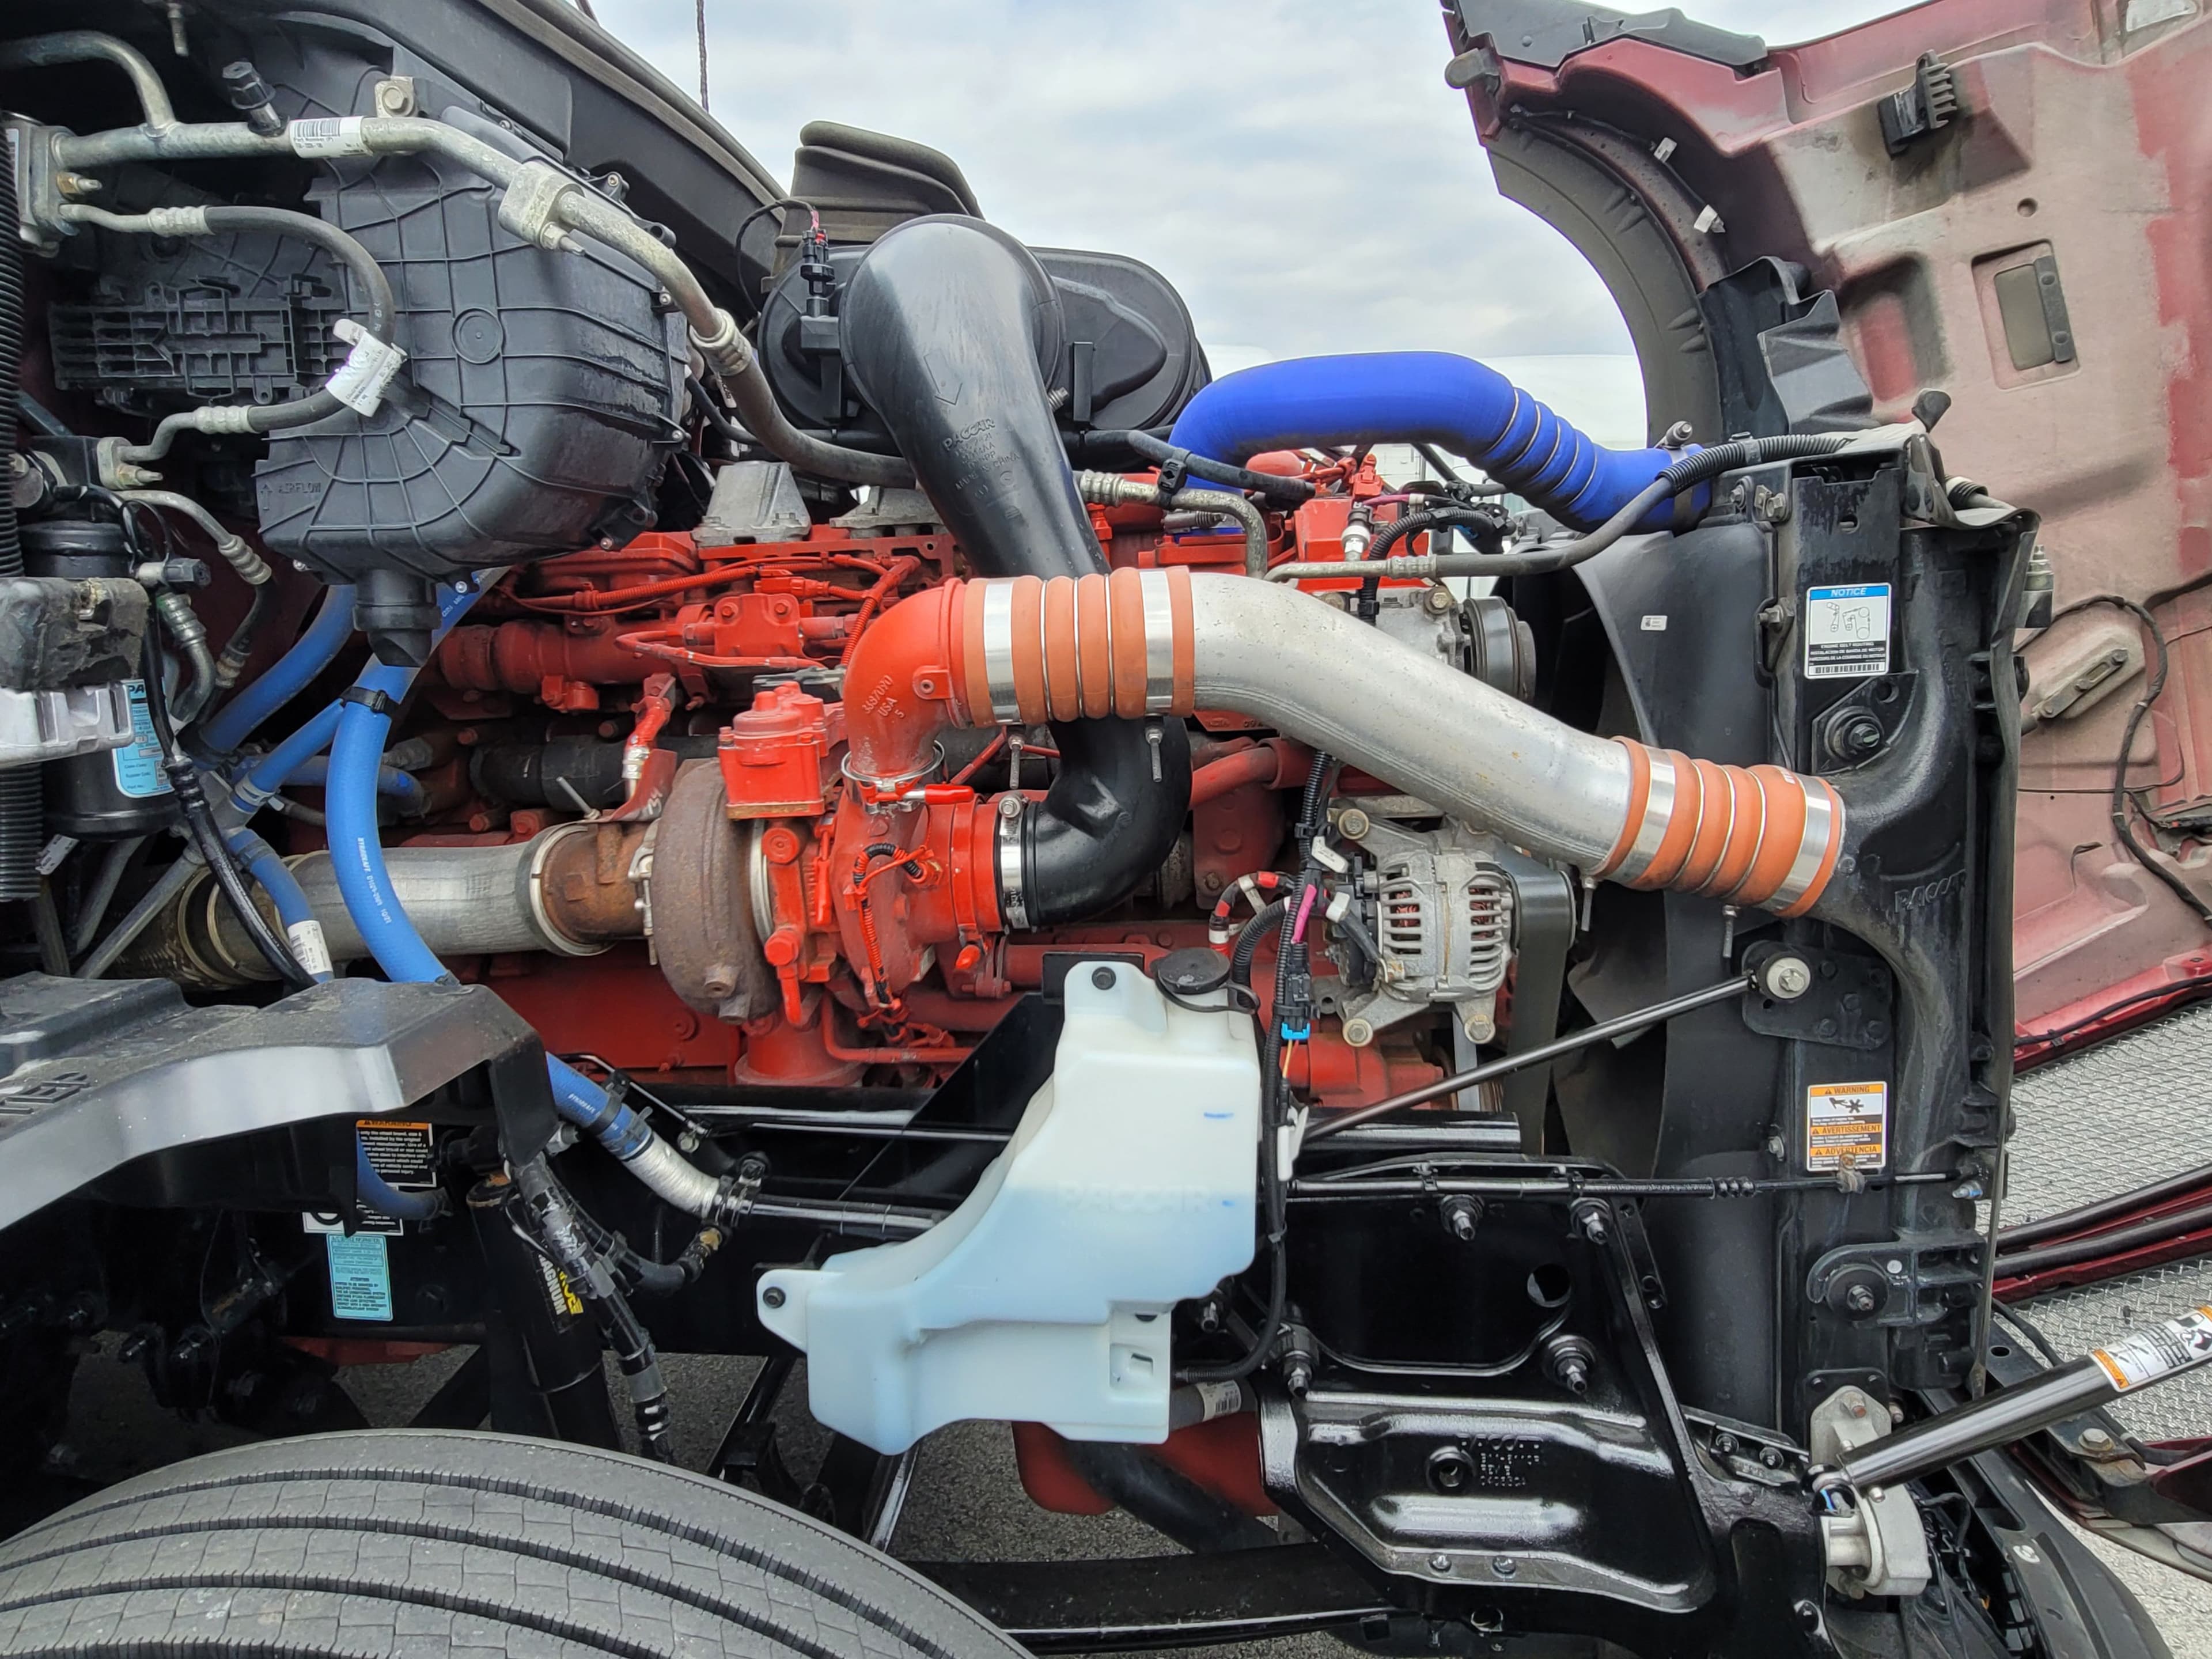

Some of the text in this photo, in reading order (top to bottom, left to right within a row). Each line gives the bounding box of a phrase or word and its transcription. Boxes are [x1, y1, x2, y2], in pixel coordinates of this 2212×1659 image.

[942, 418, 996, 452] PACCAR
[1831, 588, 1867, 597] NOTICE
[877, 698, 897, 716] USA
[1834, 1086, 1870, 1094] WARNING
[1822, 1124, 1880, 1134] AVERTISSEMENT
[1825, 1146, 1877, 1154] ADVERTENCIA
